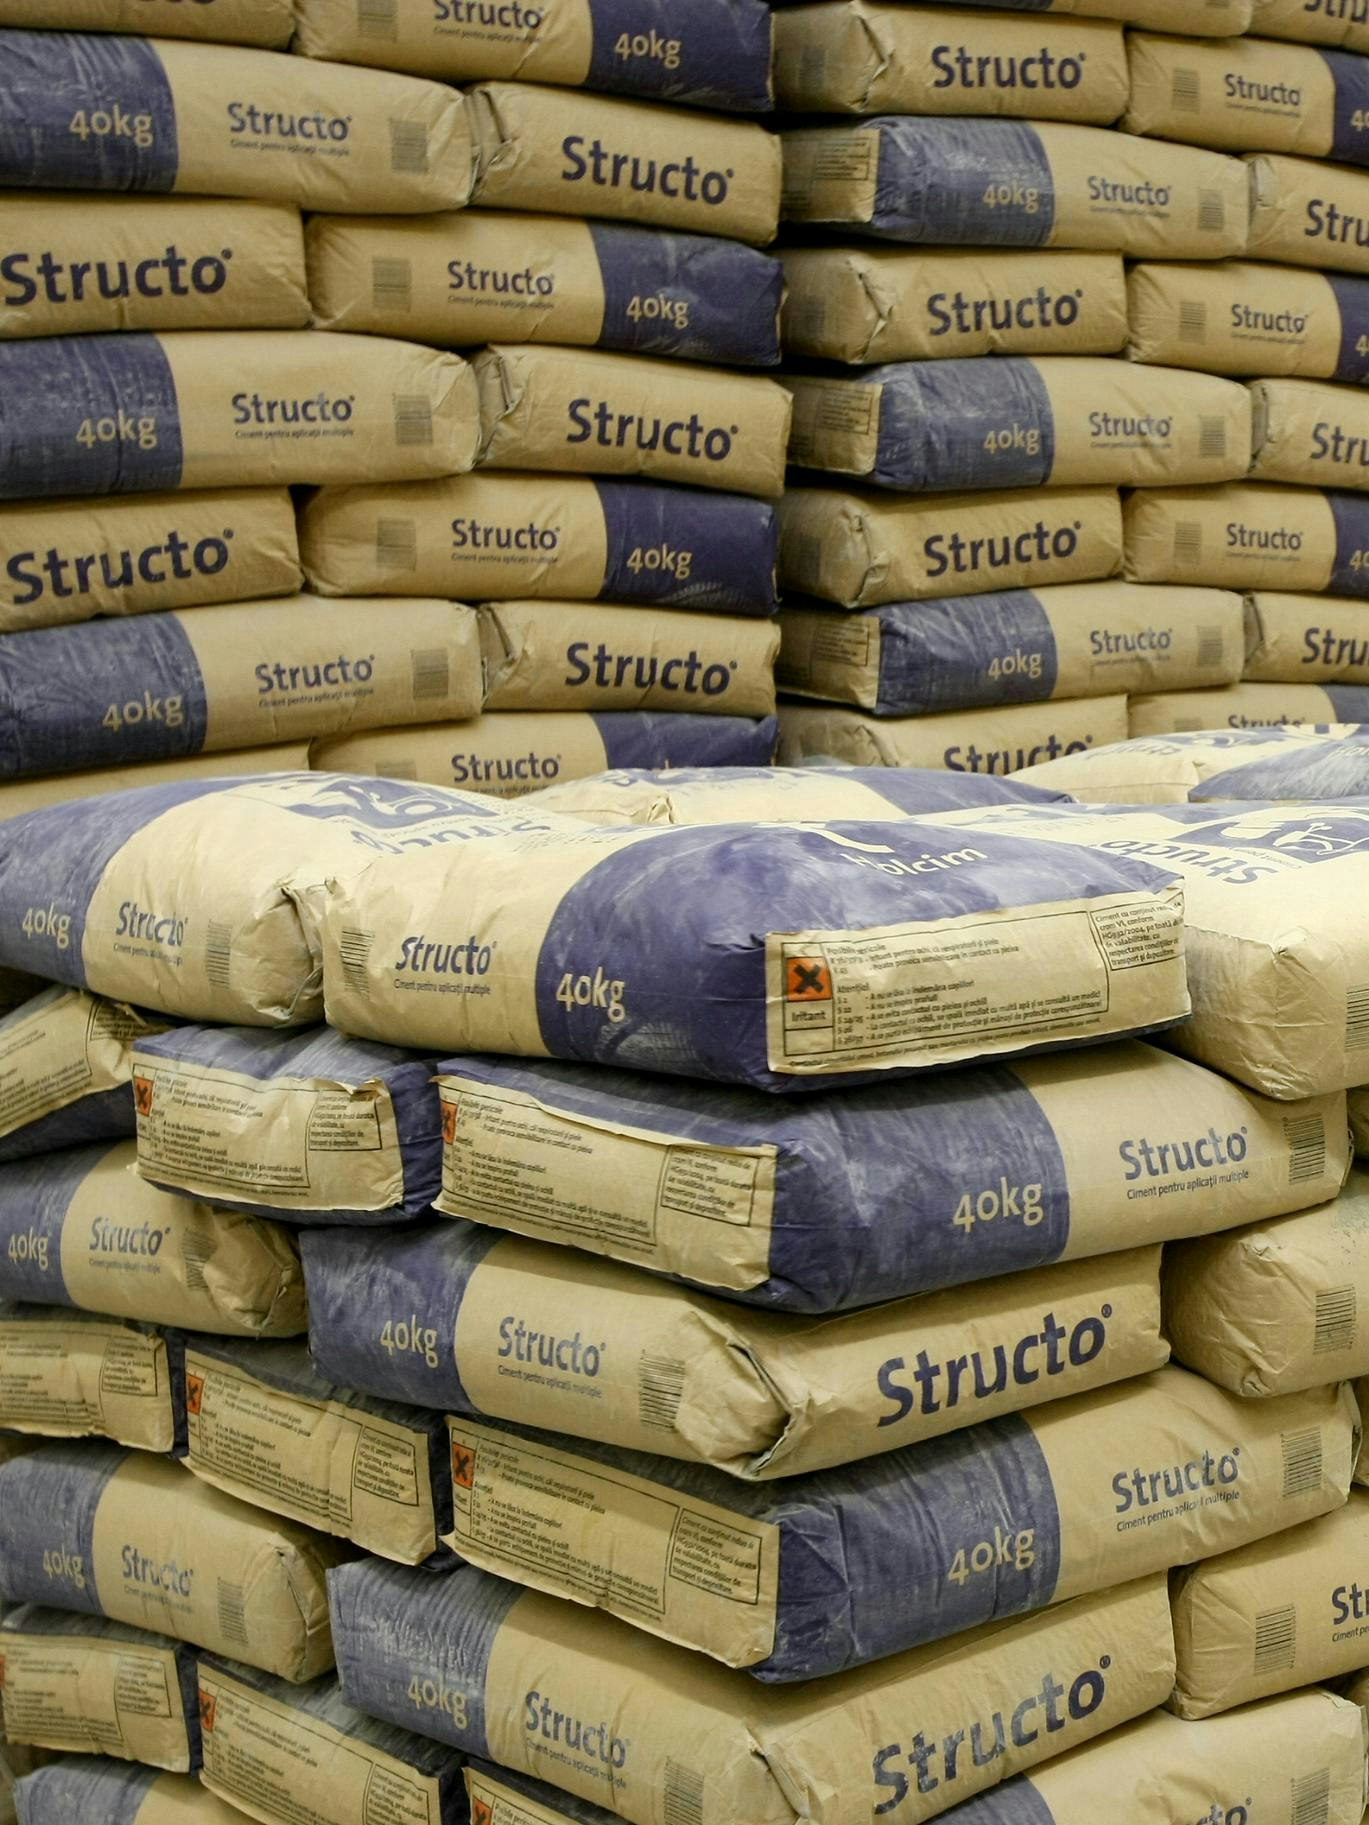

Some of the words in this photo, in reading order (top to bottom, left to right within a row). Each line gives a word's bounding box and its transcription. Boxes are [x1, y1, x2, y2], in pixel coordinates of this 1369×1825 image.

[855, 843, 985, 880] Holcim
[1127, 1186, 1157, 1199] Ciment
[1159, 1181, 1185, 1197] pentru
[1116, 1516, 1145, 1532] Ciment
[1147, 1508, 1173, 1525] pentru
